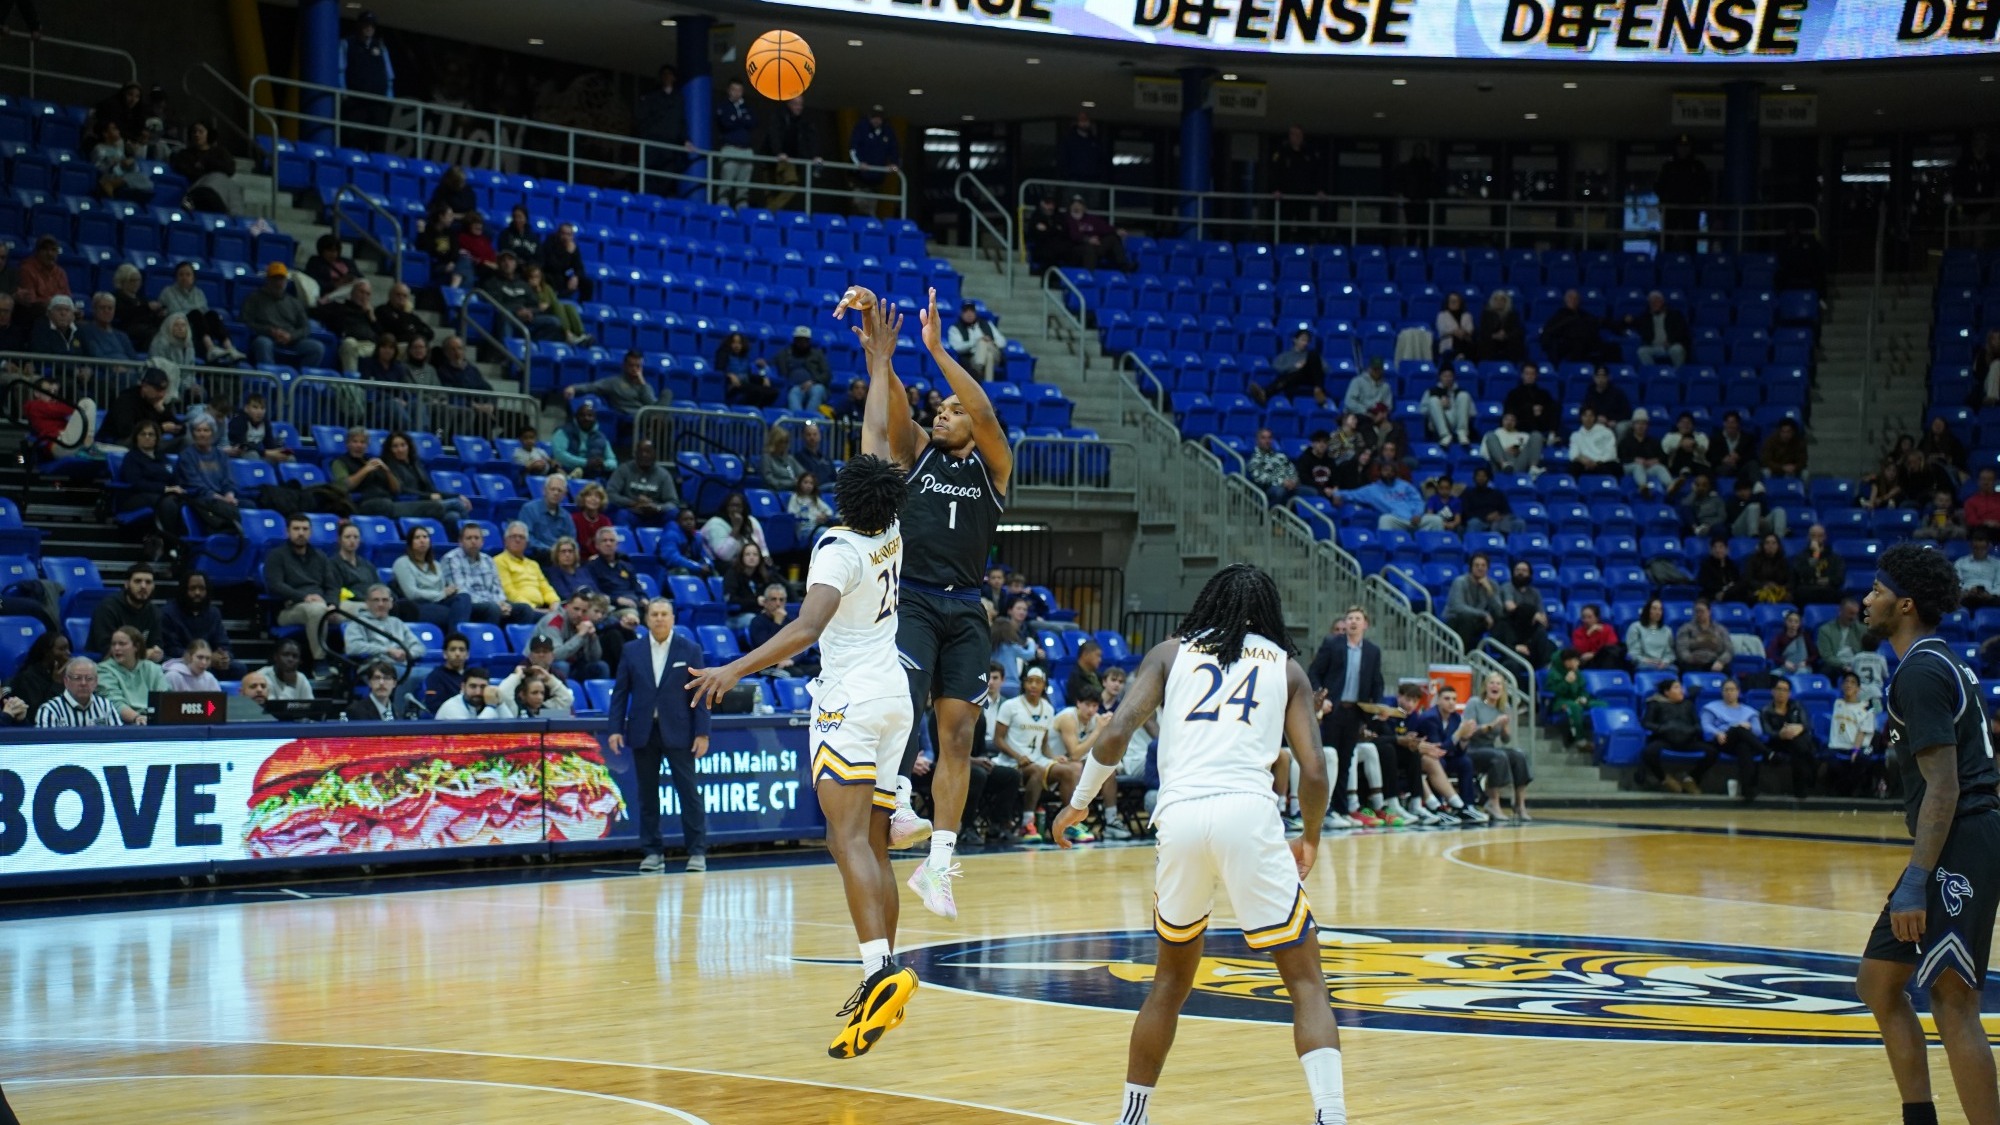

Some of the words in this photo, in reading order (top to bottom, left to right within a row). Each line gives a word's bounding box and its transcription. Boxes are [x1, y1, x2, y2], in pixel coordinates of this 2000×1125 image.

[1501, 0, 1804, 52] DEFENSE
[948, 501, 958, 530] 1
[874, 560, 899, 624] 21
[180, 702, 204, 715] POSS.
[1184, 662, 1261, 726] 24
[1028, 735, 1038, 754] 4
[733, 749, 778, 774] Main
[780, 750, 798, 772] St
[768, 780, 800, 810] CT
